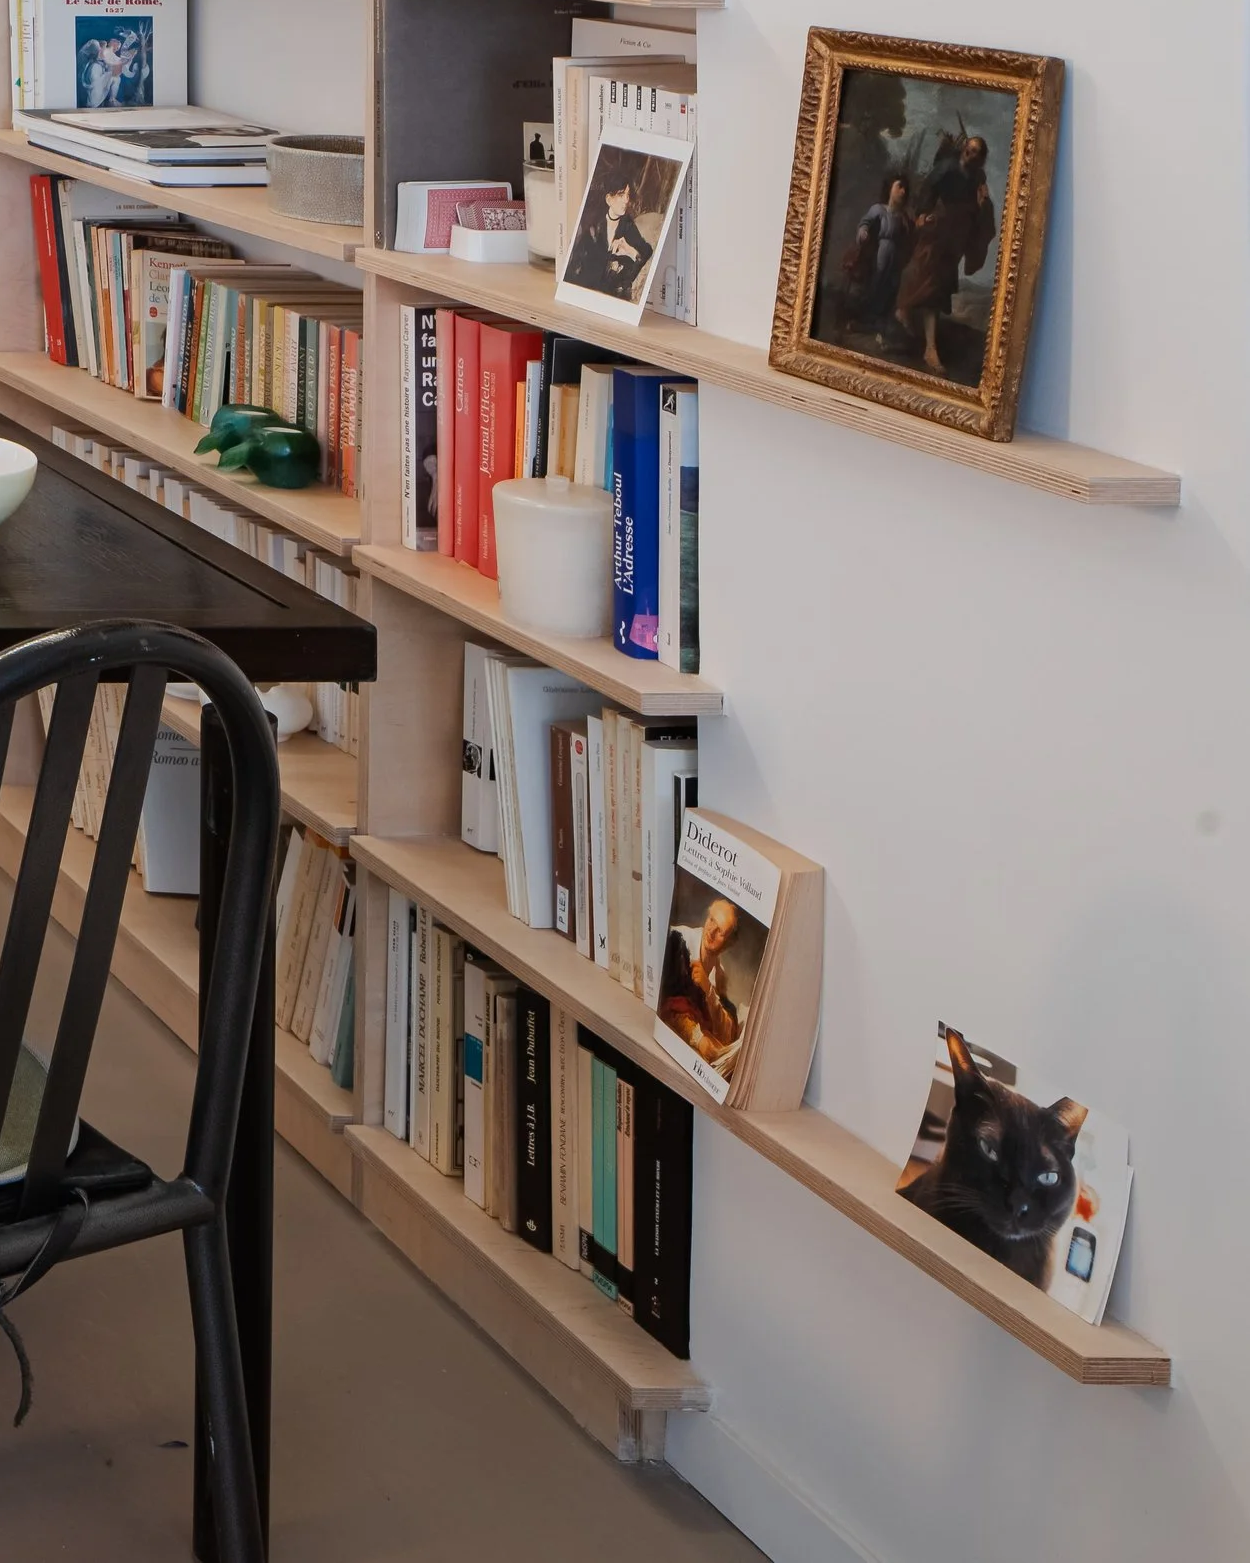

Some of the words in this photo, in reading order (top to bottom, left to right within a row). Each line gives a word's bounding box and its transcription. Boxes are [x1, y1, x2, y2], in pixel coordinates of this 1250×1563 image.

[619, 37, 637, 47] Fiction
[149, 270, 169, 281] Clar
[149, 295, 160, 303] de
[402, 313, 410, 342] Carver
[202, 327, 213, 391] ALEXANDRE
[402, 344, 410, 383] Raymond
[307, 345, 315, 431] LEOPARDI
[349, 368, 357, 411] POUND
[455, 357, 465, 413] Carnets
[480, 370, 490, 423] d'Helen
[328, 392, 336, 452] FERNANDO
[479, 425, 492, 478] Journal
[613, 471, 622, 528] Teboul
[613, 531, 622, 590] Arthur
[623, 516, 634, 595] L'Adresse
[152, 750, 188, 766] Romeo
[157, 730, 187, 742] omeo
[687, 820, 738, 868] Diderot
[683, 841, 707, 864] Lettres
[713, 861, 738, 883] Sophie
[739, 876, 763, 901] Volland
[418, 928, 427, 964] Robert
[418, 973, 426, 1039] DUCHAMP
[526, 1009, 535, 1057] Dubuffet
[527, 1058, 536, 1084] Jean
[527, 1103, 535, 1120] J.B.
[527, 1131, 535, 1167] Lettres
[559, 1163, 567, 1206] BENJAMIN
